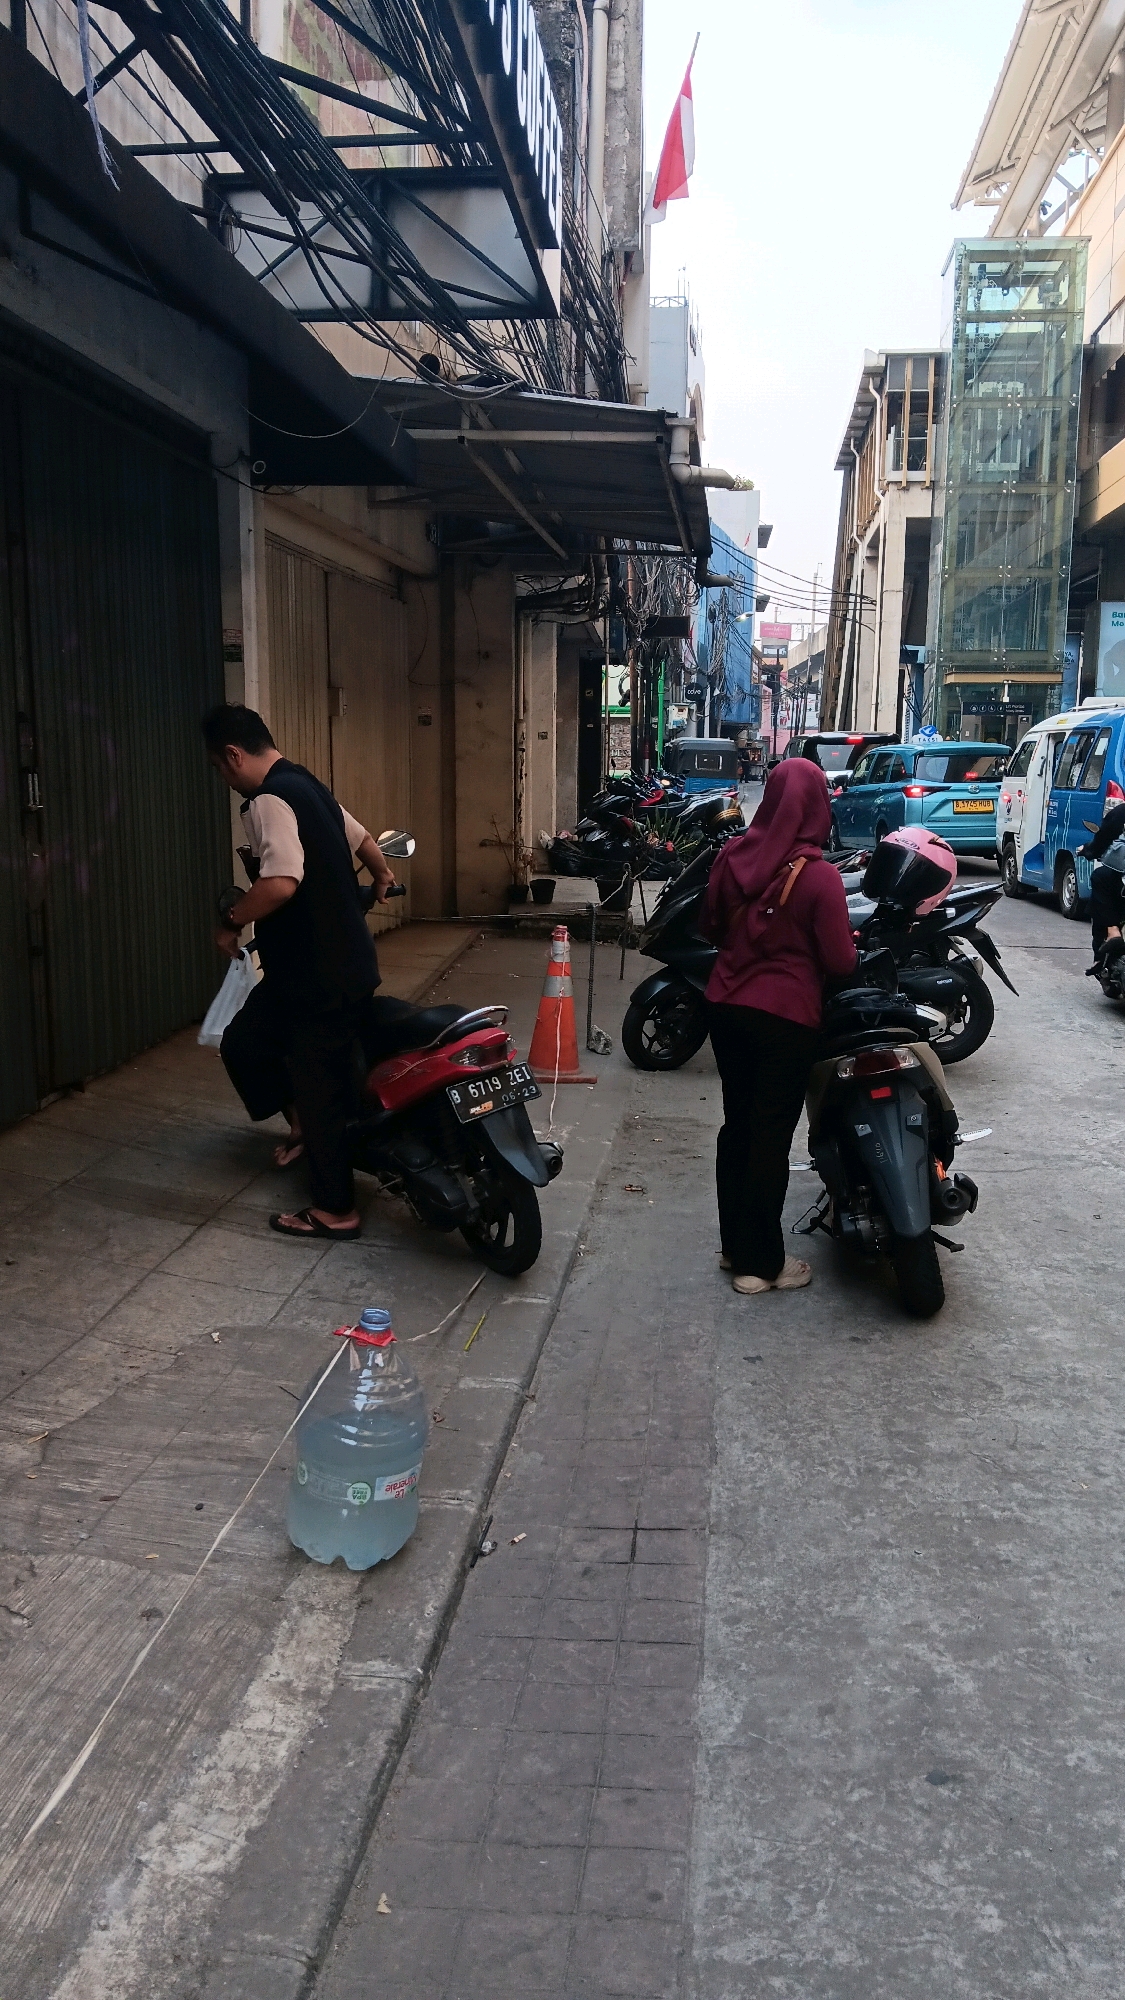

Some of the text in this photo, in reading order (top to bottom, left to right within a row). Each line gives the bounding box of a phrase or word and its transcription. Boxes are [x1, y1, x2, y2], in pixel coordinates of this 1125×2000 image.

[1112, 611, 1125, 619] Ba
[450, 1066, 531, 1104] B 6719 ZEI
